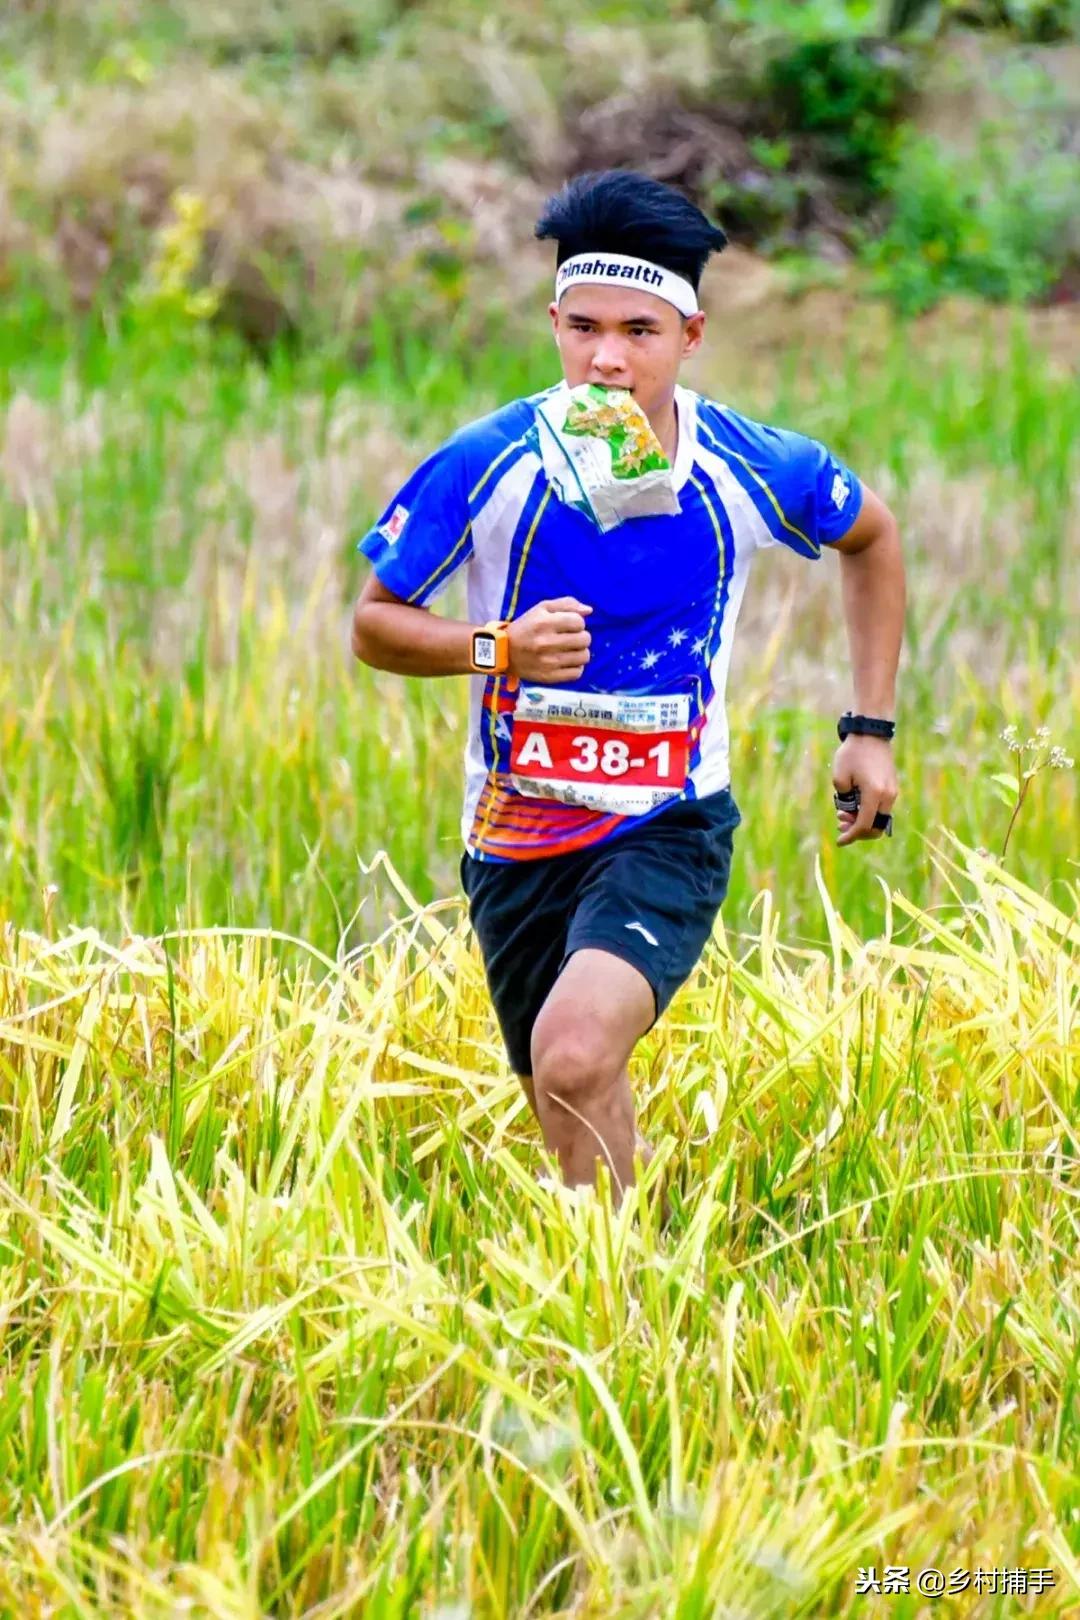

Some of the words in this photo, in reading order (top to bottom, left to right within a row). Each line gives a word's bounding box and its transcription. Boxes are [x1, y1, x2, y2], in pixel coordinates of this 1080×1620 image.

[559, 260, 664, 287] hinahealth
[516, 732, 553, 768] A
[569, 736, 671, 778] 38-1
